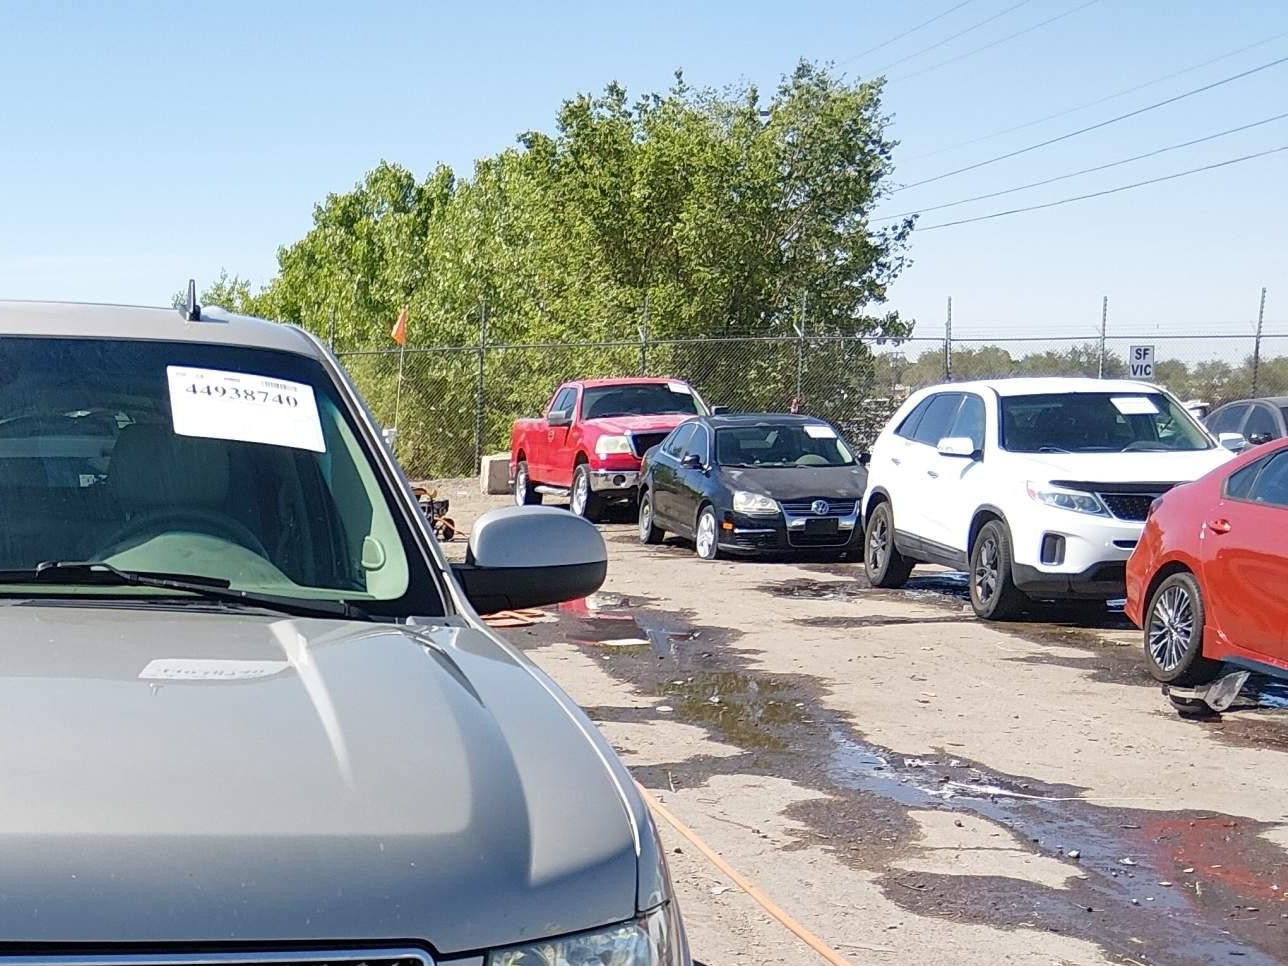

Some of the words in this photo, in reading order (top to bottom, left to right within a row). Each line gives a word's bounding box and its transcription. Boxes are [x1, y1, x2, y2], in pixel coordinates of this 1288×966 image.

[1134, 347, 1150, 361] SF
[1131, 364, 1152, 376] VIC
[185, 383, 299, 408] 44938740
